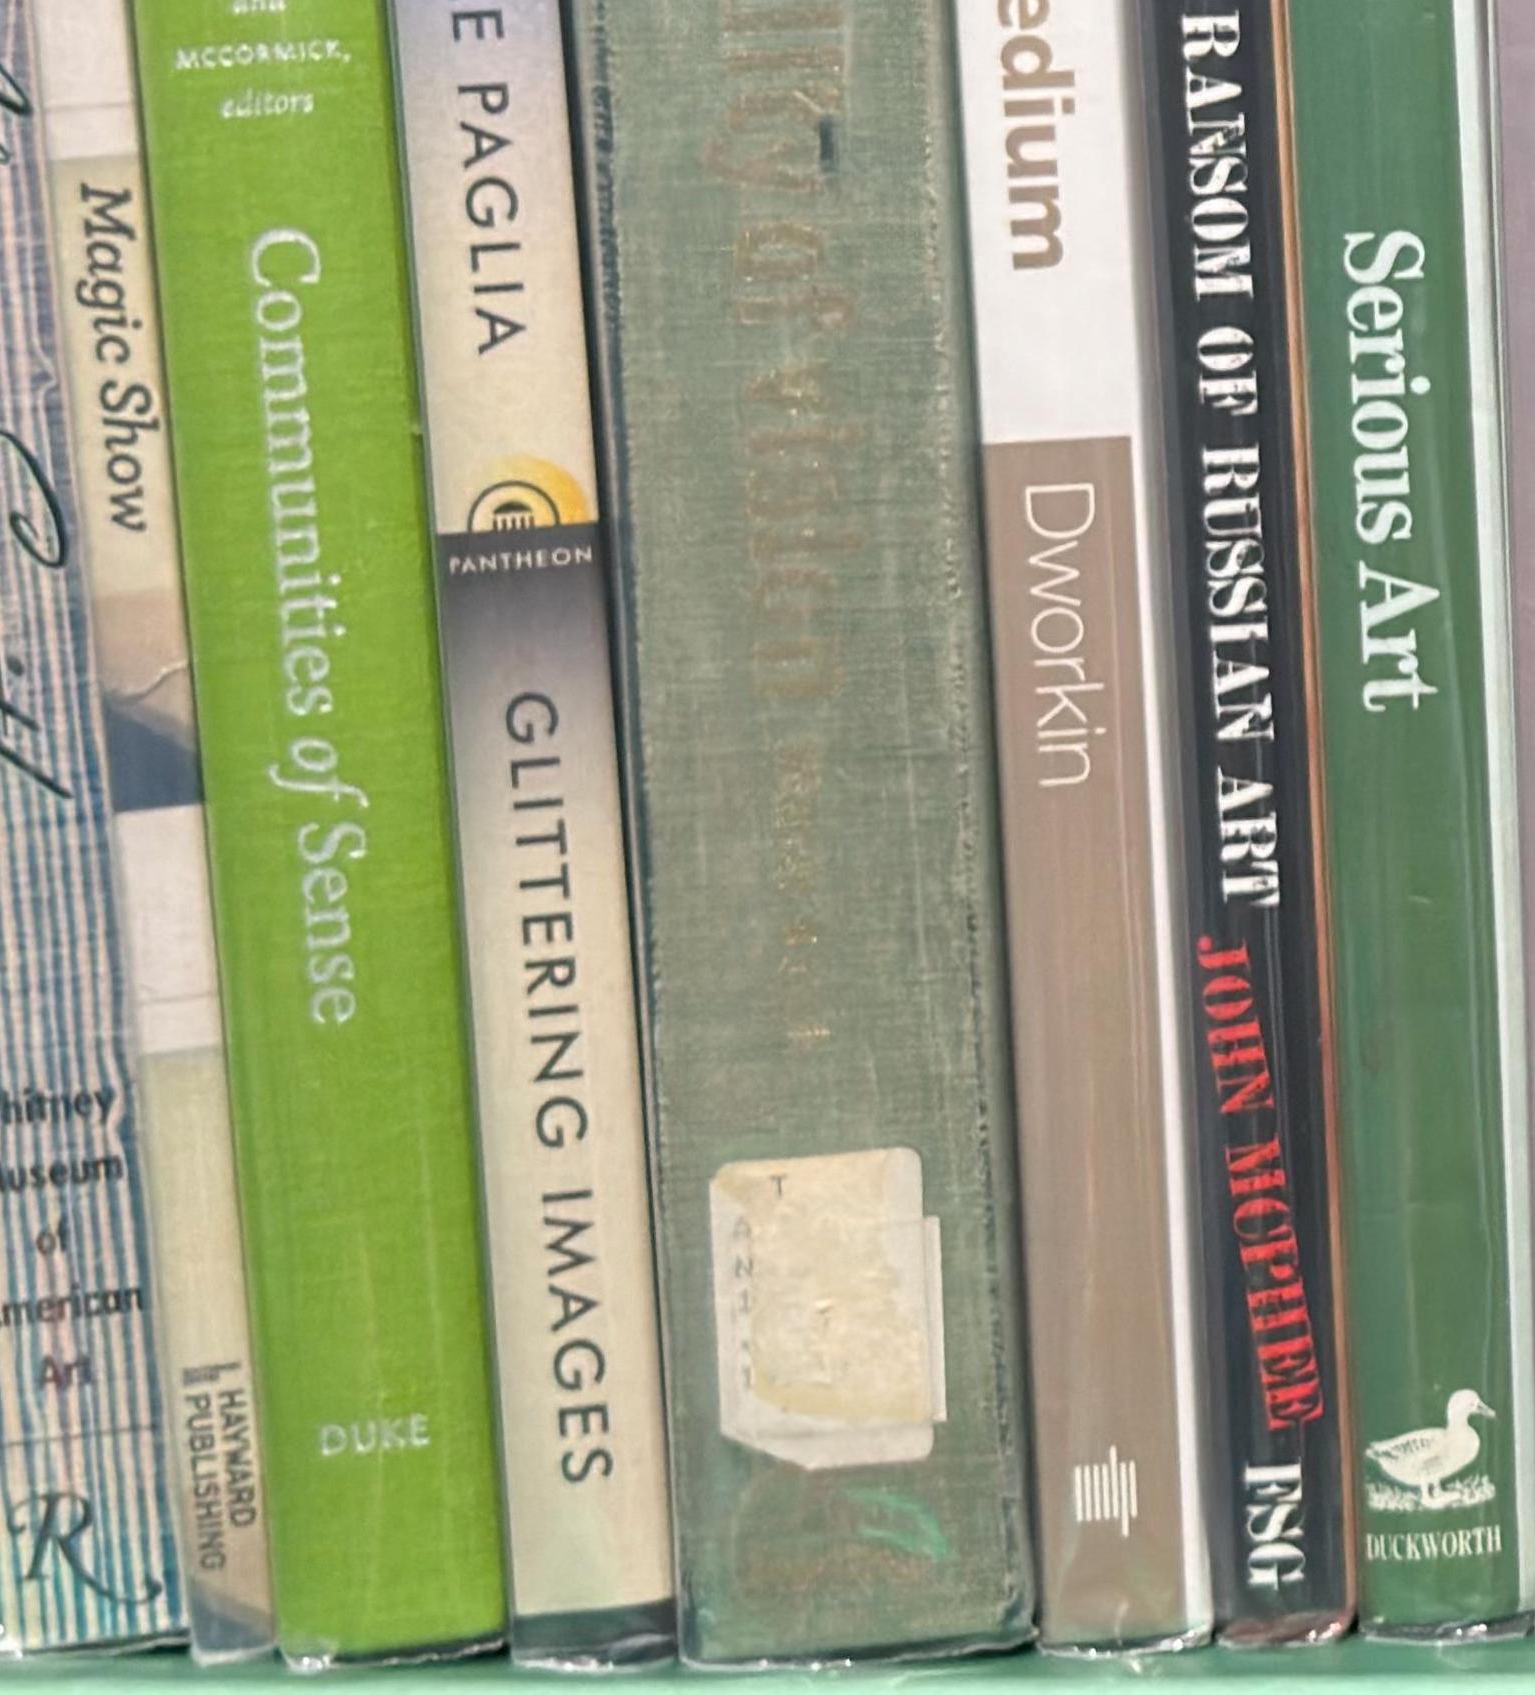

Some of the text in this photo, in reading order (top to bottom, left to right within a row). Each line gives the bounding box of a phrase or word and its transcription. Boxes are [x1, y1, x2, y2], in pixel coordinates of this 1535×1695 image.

[457, 83, 527, 356] PAGLIA
[76, 181, 160, 534] Magic Show
[1341, 229, 1441, 713] Serious Art
[249, 227, 368, 1025] Communities of Sense
[450, 545, 591, 574] PANTHEON
[504, 690, 615, 1486] GLITTERING IMAGES
[34, 1224, 70, 1257] of
[39, 1357, 94, 1390] Art
[1366, 1525, 1501, 1561] DUCKWORTH
